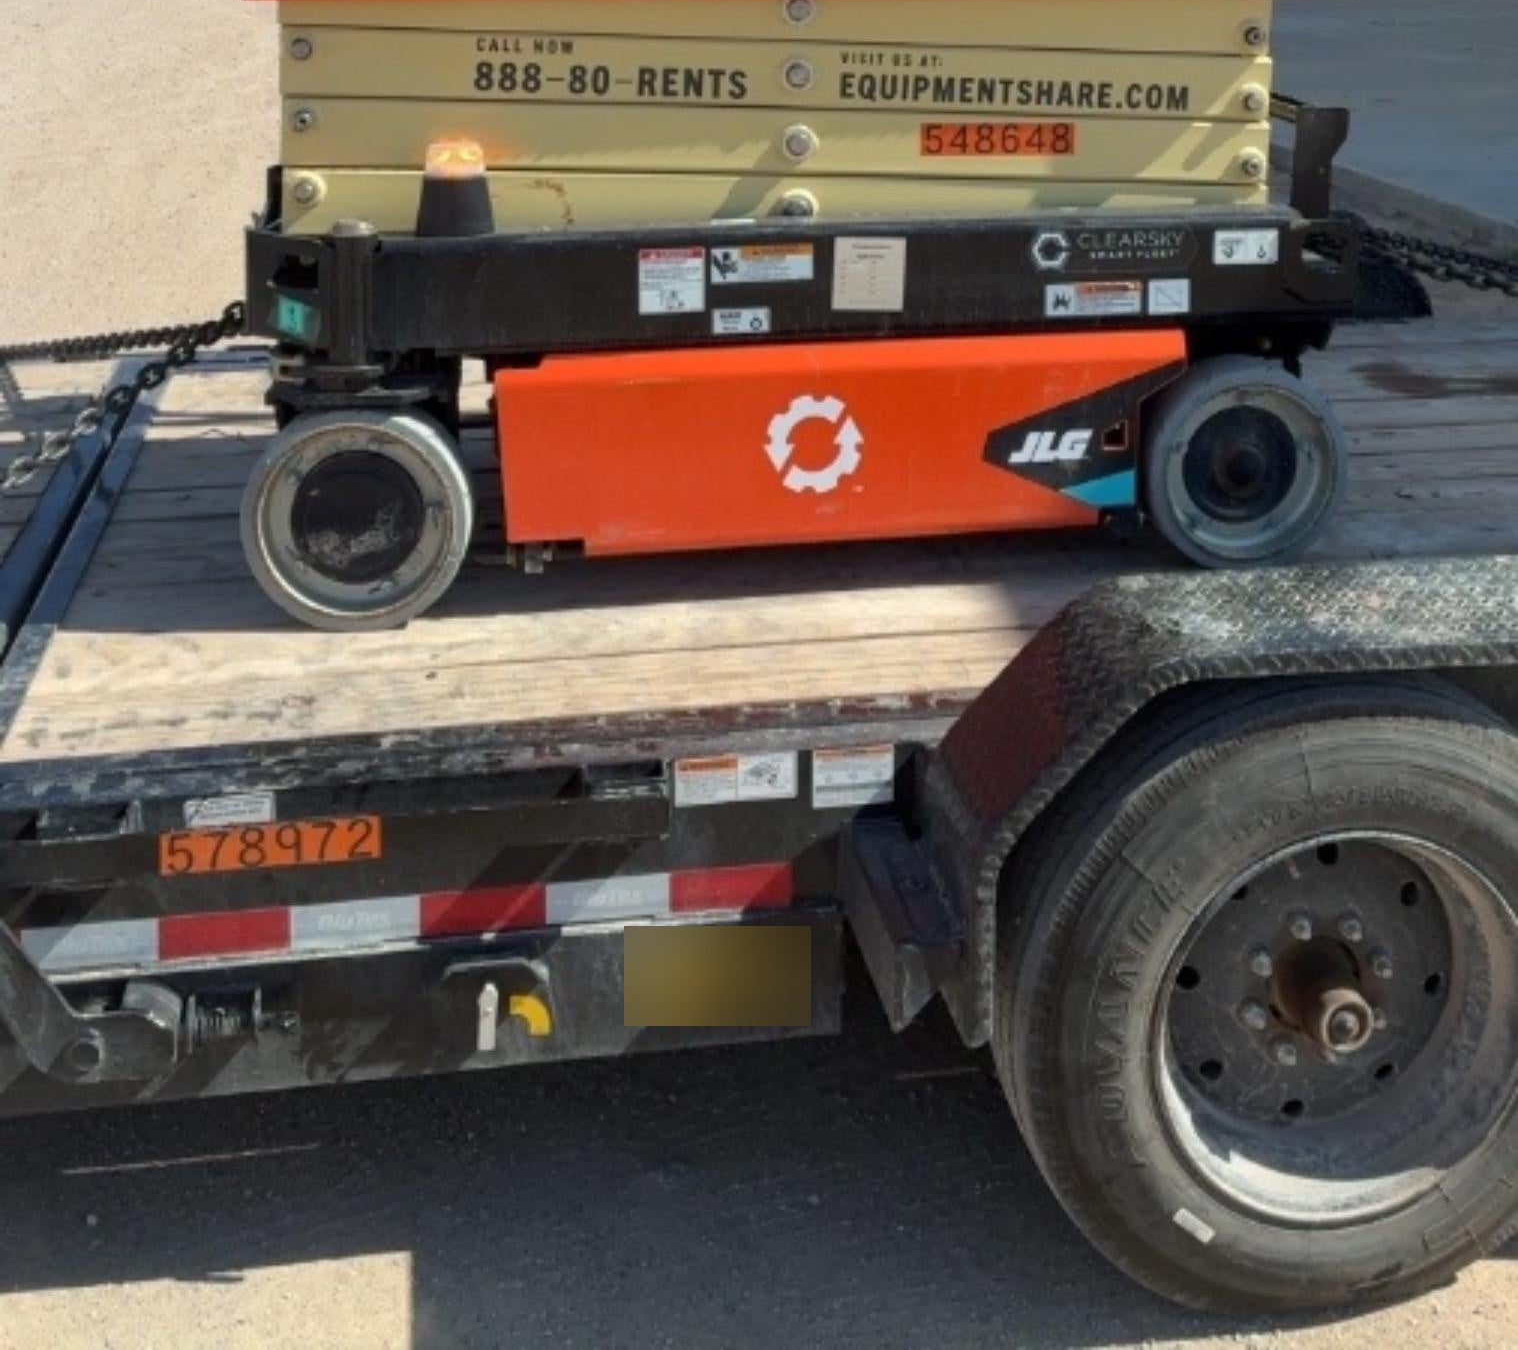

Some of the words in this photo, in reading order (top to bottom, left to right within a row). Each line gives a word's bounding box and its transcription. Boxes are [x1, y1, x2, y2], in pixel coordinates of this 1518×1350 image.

[476, 38, 522, 54] CALL
[533, 39, 574, 55] NOW
[840, 50, 884, 65] VISIT
[891, 53, 913, 66] US
[474, 61, 748, 100] 888-80-RENTS
[839, 71, 1190, 112] EQUIPMENTSHARE.COM
[925, 123, 1073, 154] 548648
[1077, 230, 1184, 250] CLEARSKY
[1008, 427, 1094, 464] JLG
[166, 817, 375, 873] 578972
